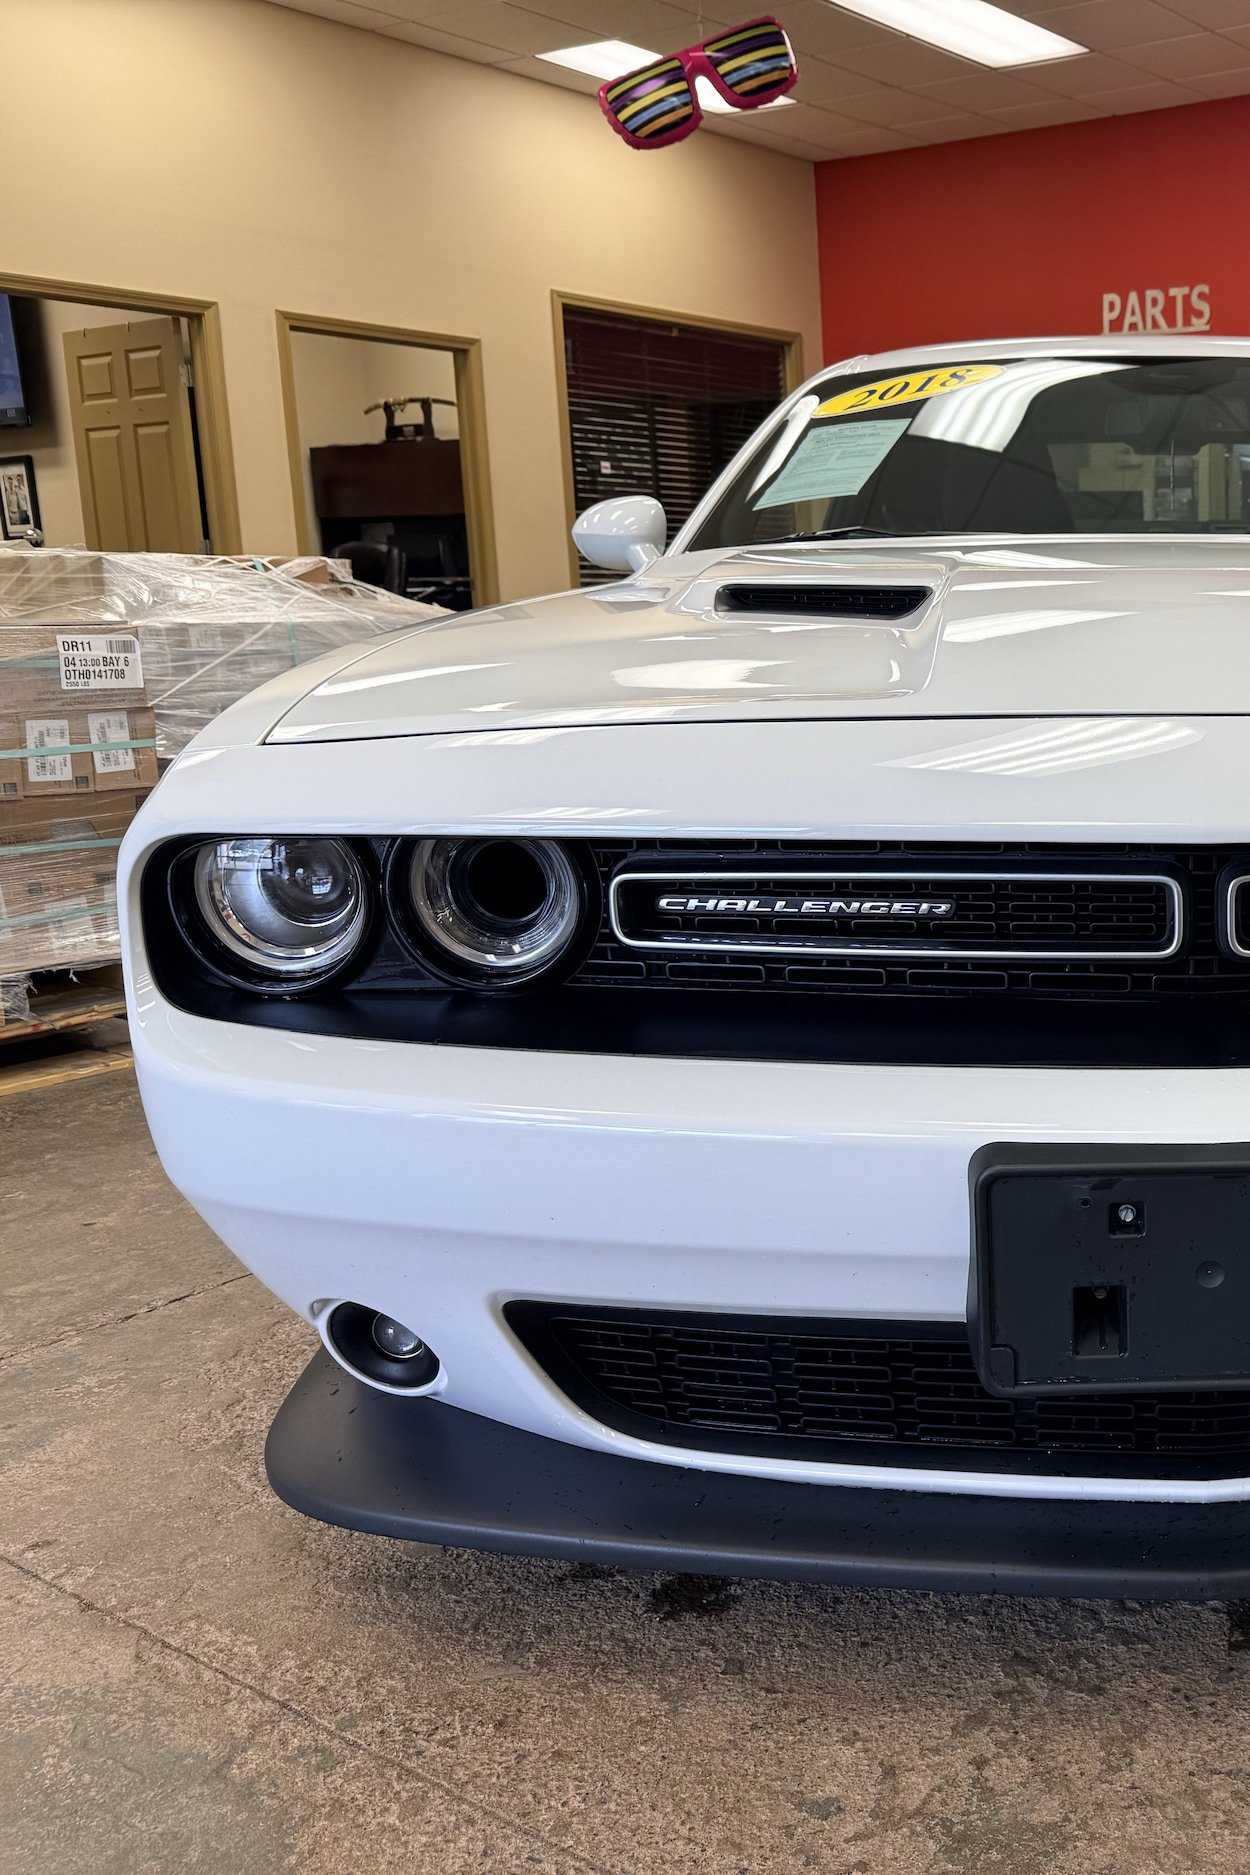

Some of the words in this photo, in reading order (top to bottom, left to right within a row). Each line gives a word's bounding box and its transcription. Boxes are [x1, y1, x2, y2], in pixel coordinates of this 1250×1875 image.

[1102, 284, 1211, 335] PARTS
[843, 369, 973, 411] 2018
[62, 640, 92, 652] DR11
[64, 656, 76, 667] 04
[79, 658, 101, 667] 13:00
[102, 656, 121, 667] BAY
[124, 656, 129, 667] 6
[658, 898, 951, 915] CHALLENGER
